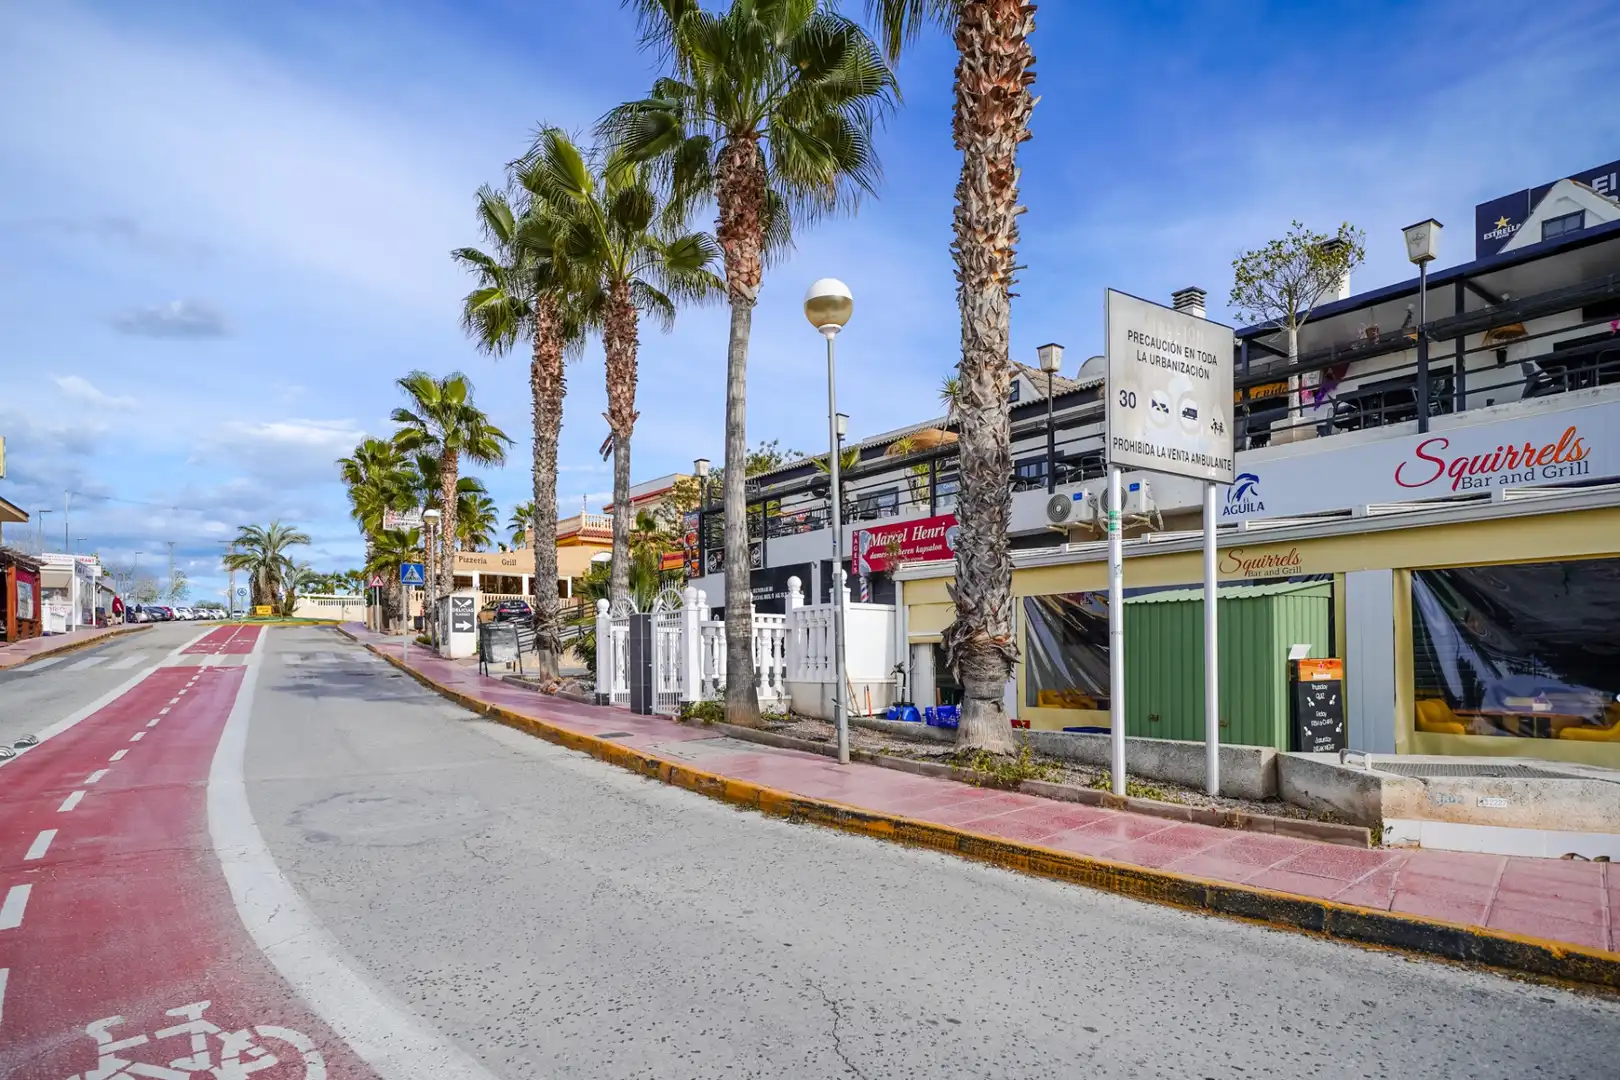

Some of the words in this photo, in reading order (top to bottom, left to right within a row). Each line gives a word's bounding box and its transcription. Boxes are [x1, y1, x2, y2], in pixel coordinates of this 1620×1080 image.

[1128, 330, 1182, 356] PRECAUCIÓN
[1184, 347, 1195, 358] EN
[1197, 350, 1218, 366] TODA
[1136, 350, 1147, 362] LA
[1150, 356, 1210, 380] URBANIZACIÓN
[1119, 390, 1137, 409] 30
[1113, 437, 1155, 455] PROHIBIDA
[1156, 446, 1166, 457] LA
[1167, 448, 1190, 463] VENTA
[1191, 453, 1232, 471] AMBULANTE
[1395, 426, 1591, 492] Squirrels
[1461, 476, 1492, 489] Bar
[1499, 468, 1535, 485] and
[1542, 460, 1590, 479] Grill
[1222, 502, 1264, 516] AGUILA
[870, 528, 908, 548] Marcel
[912, 522, 945, 540] Henri
[916, 543, 942, 554] kapsalon
[458, 556, 487, 564] Pizzeria
[501, 558, 517, 566] Grill
[1219, 548, 1302, 576] Squirrels
[1264, 568, 1279, 576] and
[1282, 566, 1302, 574] Grill
